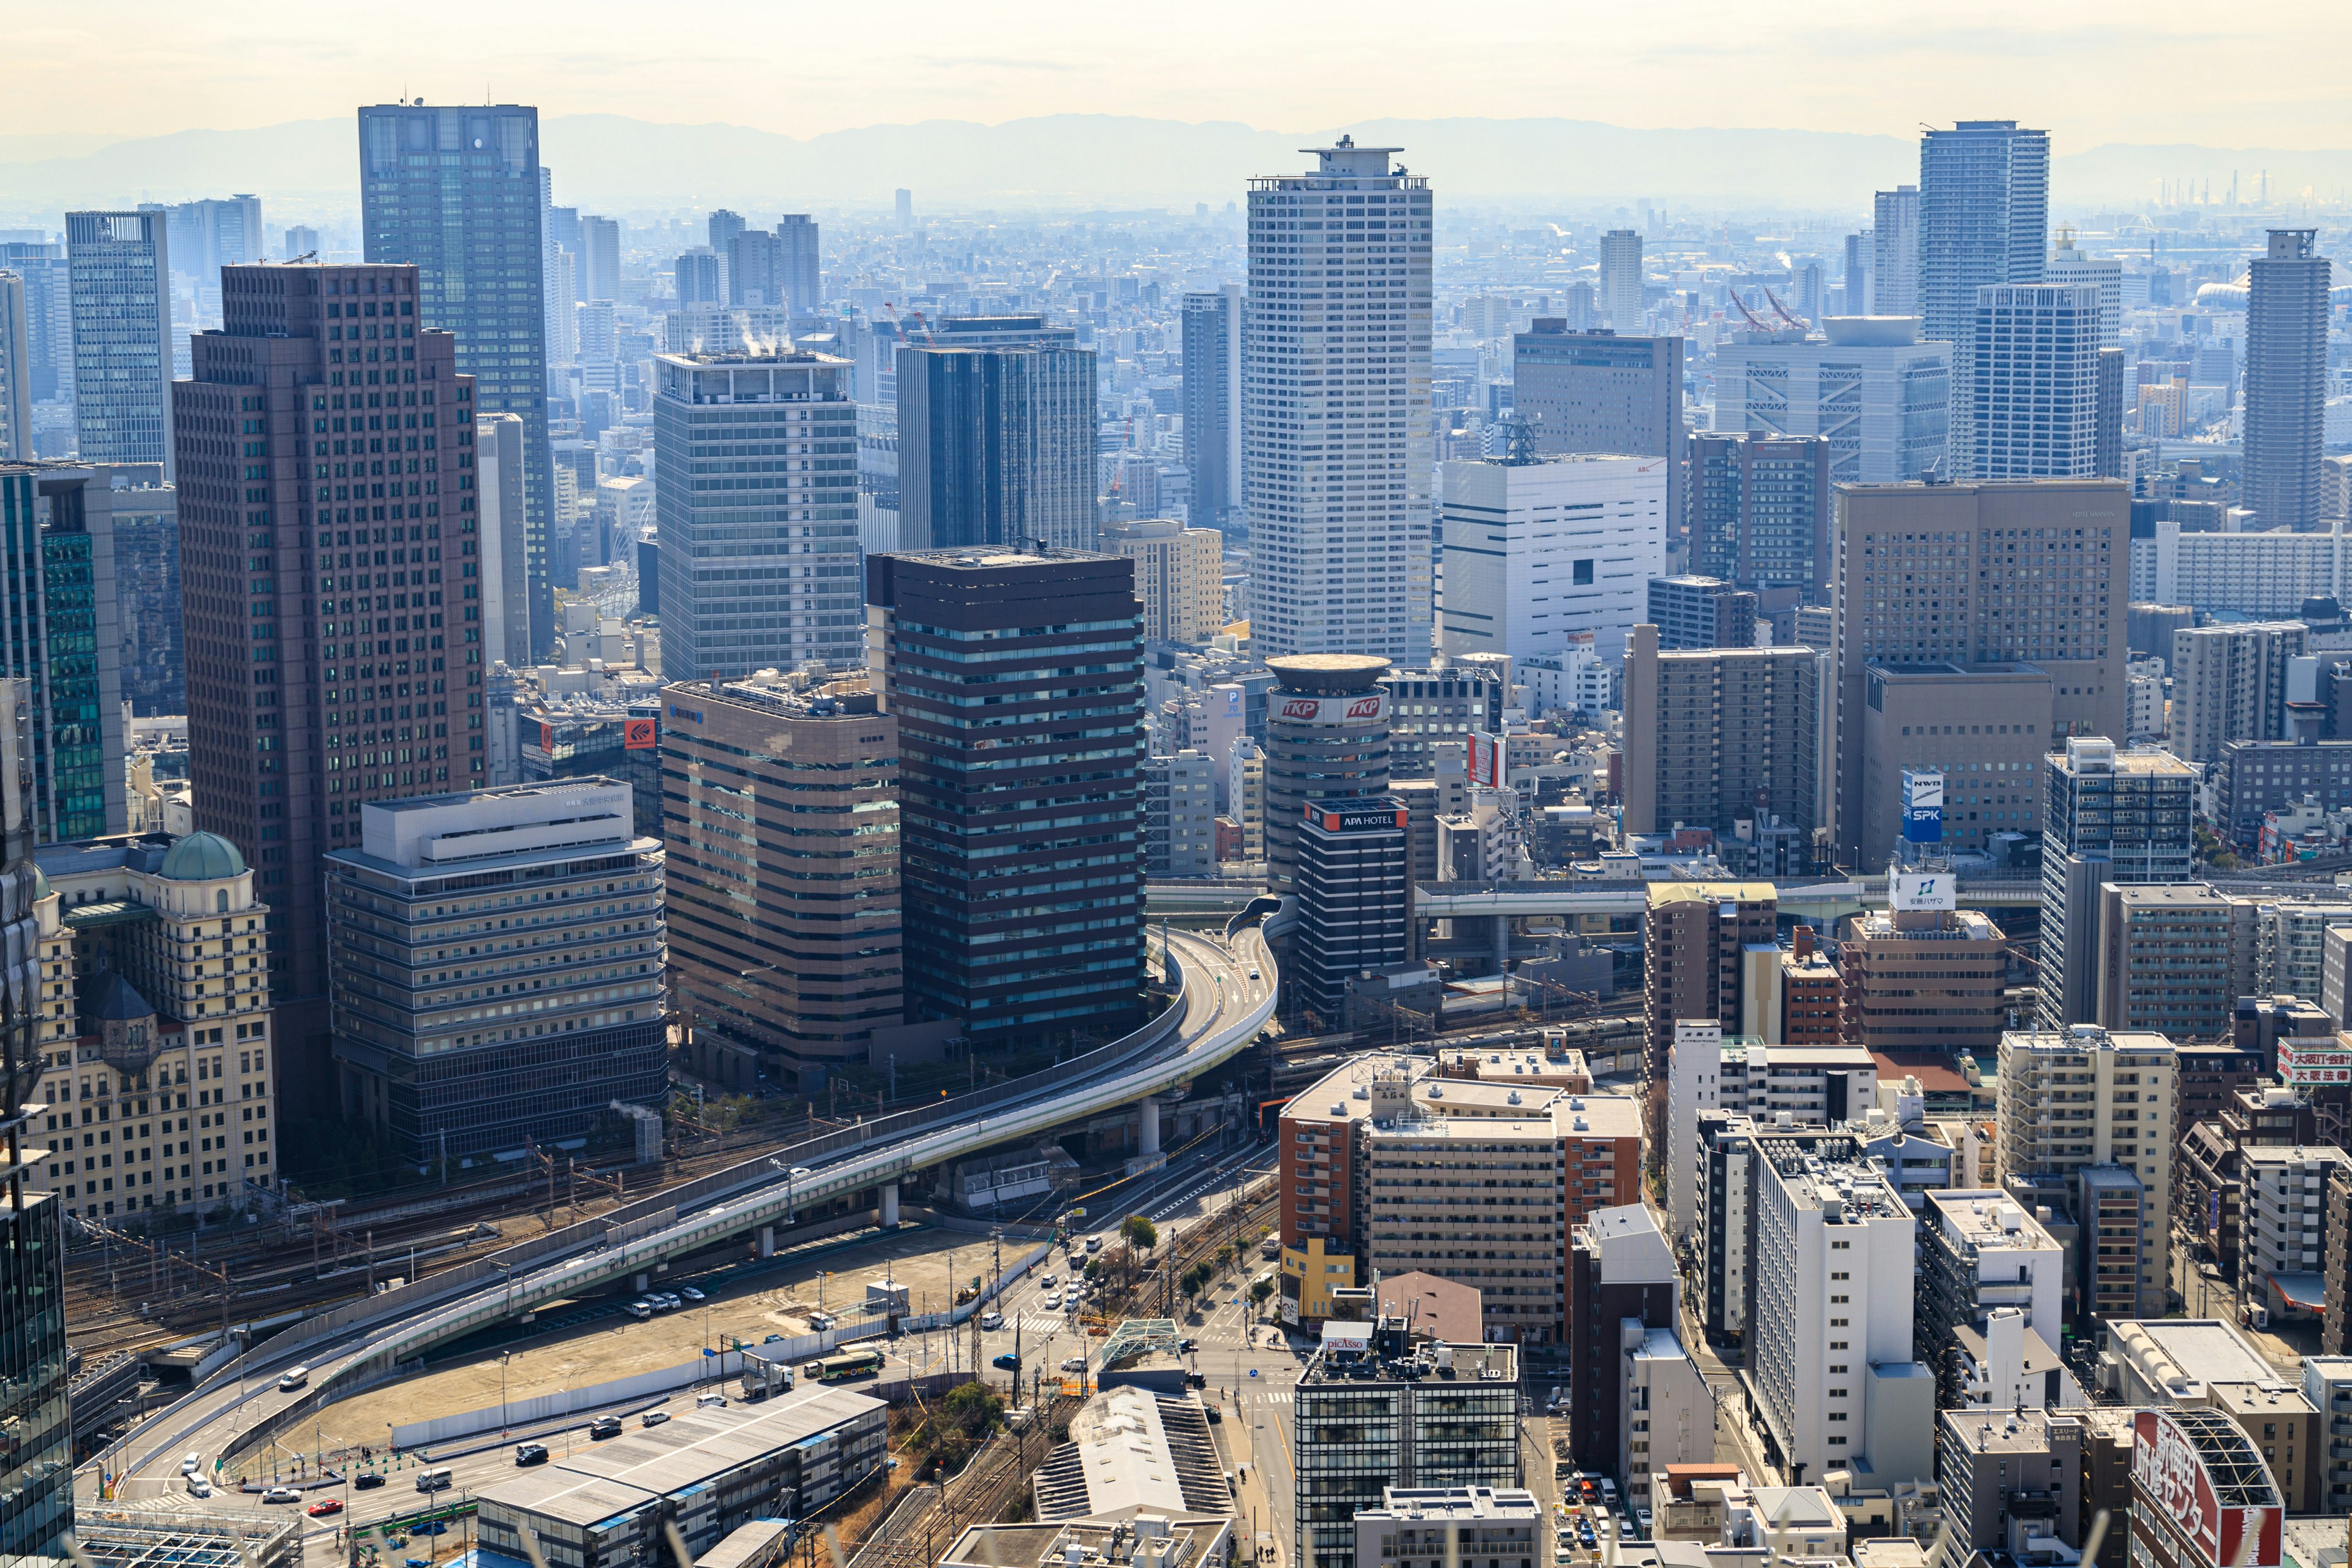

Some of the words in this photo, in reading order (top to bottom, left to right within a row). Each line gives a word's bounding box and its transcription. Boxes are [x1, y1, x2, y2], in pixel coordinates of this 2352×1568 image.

[1229, 692, 1237, 702] P
[1286, 702, 1316, 715] TKP
[1351, 699, 1379, 715] TKP
[1311, 810, 1320, 823] APA
[1364, 816, 1393, 824] HOTEL
[1913, 810, 1940, 821] SPK
[2296, 1070, 2348, 1081] 大阪法律
[2294, 1302, 2312, 1311] ENEOS
[2136, 1432, 2216, 1547] 研修センター
